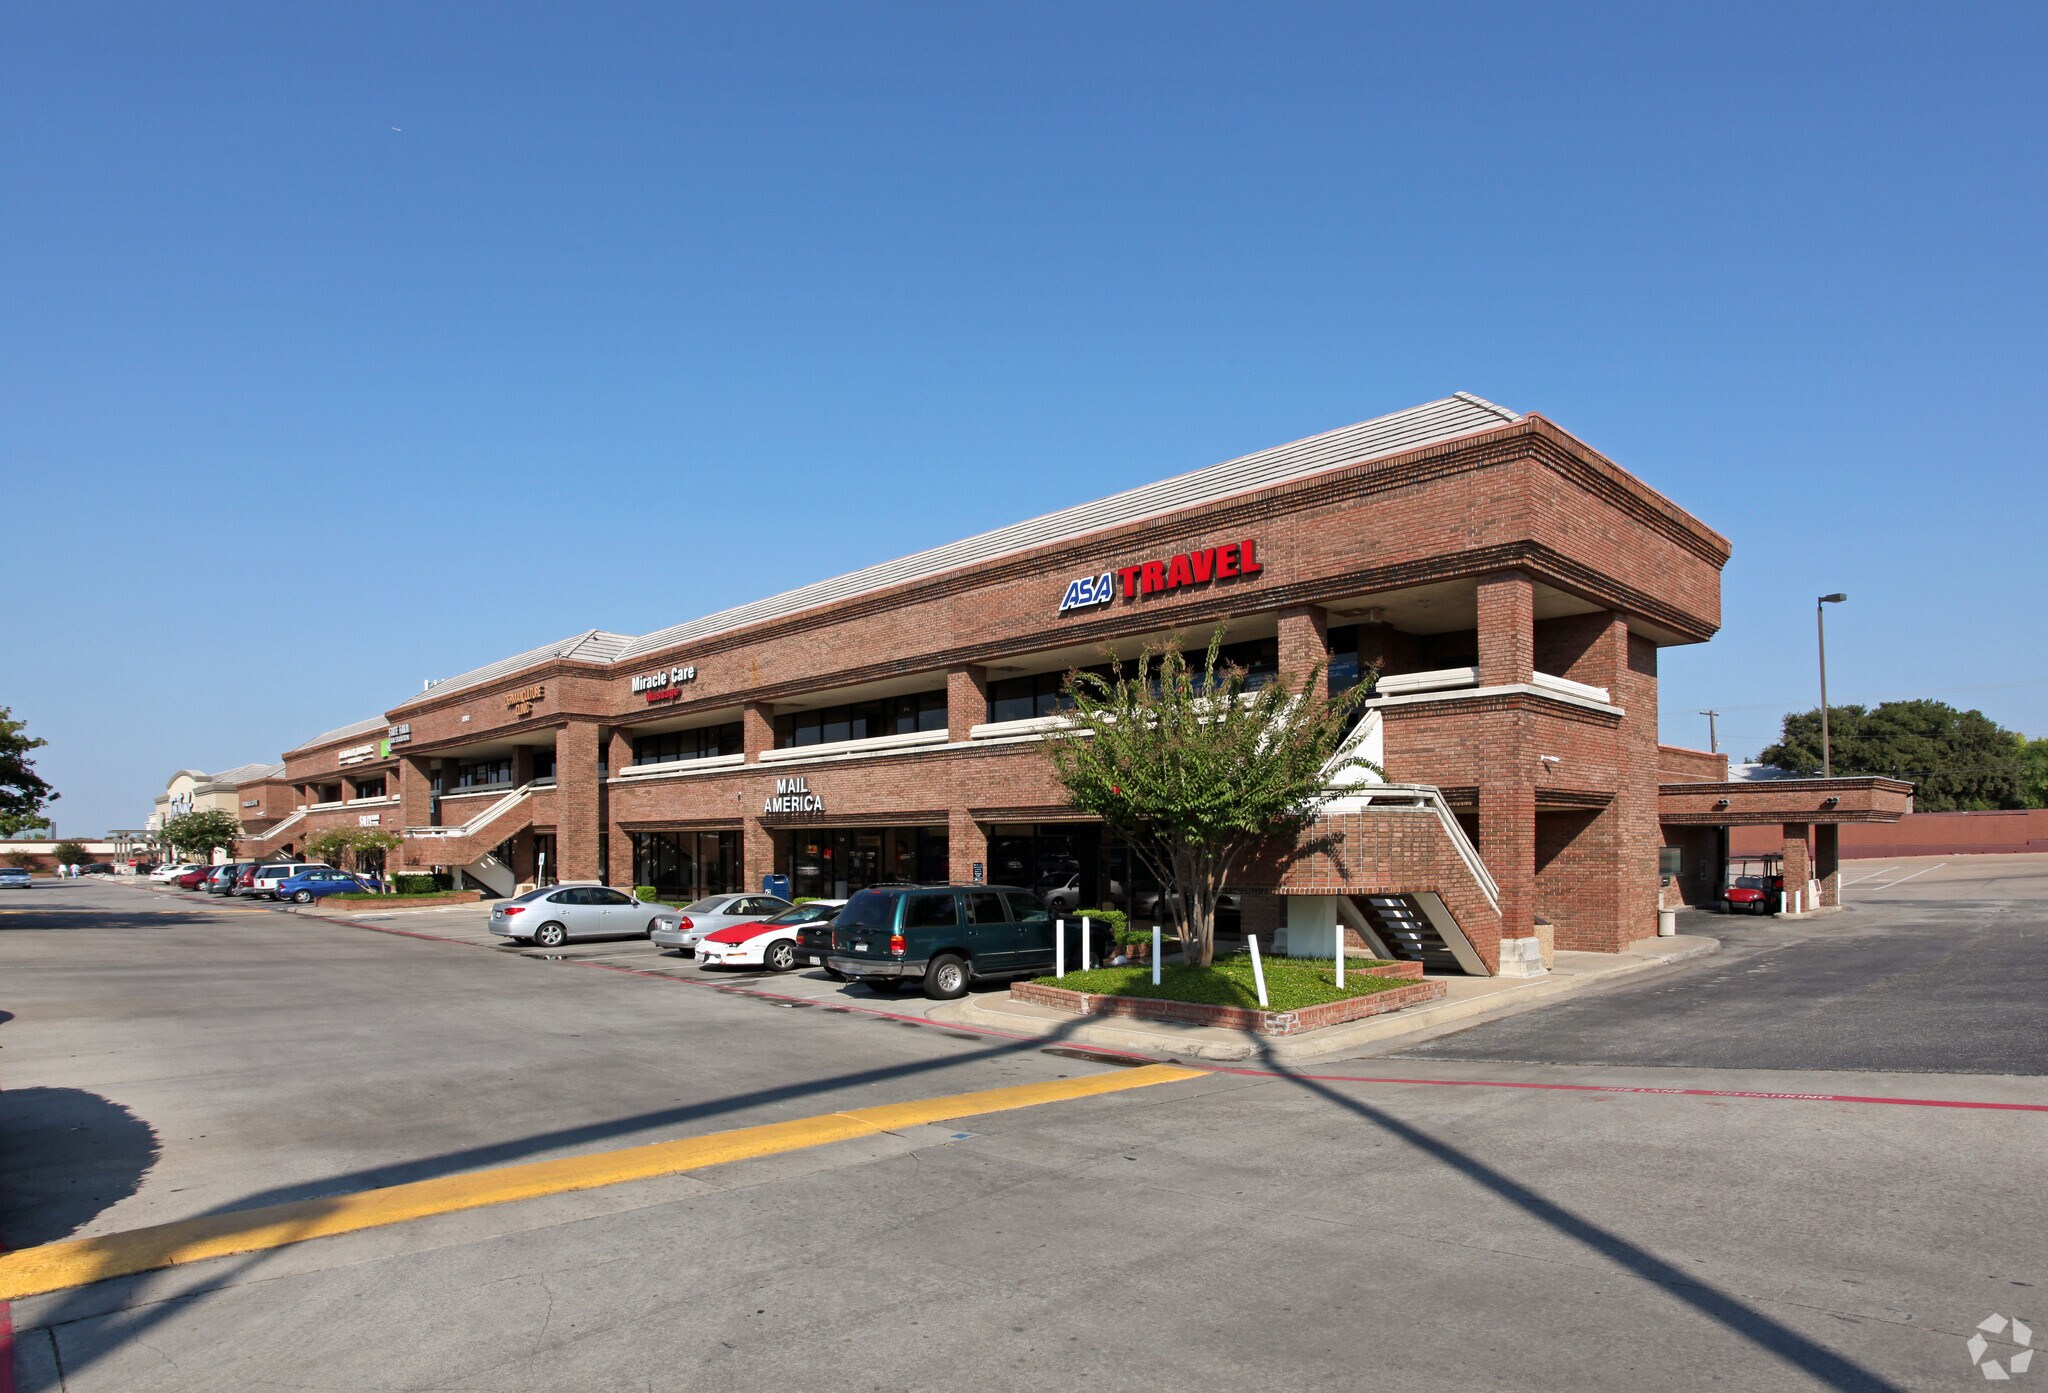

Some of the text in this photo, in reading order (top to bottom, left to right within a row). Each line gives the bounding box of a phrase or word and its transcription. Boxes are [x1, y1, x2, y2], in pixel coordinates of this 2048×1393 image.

[1059, 539, 1262, 611] ASA TRAVEL
[631, 666, 695, 692] Miracle Care
[646, 687, 680, 702] Massage
[1744, 1092, 1834, 1100] PARKING
